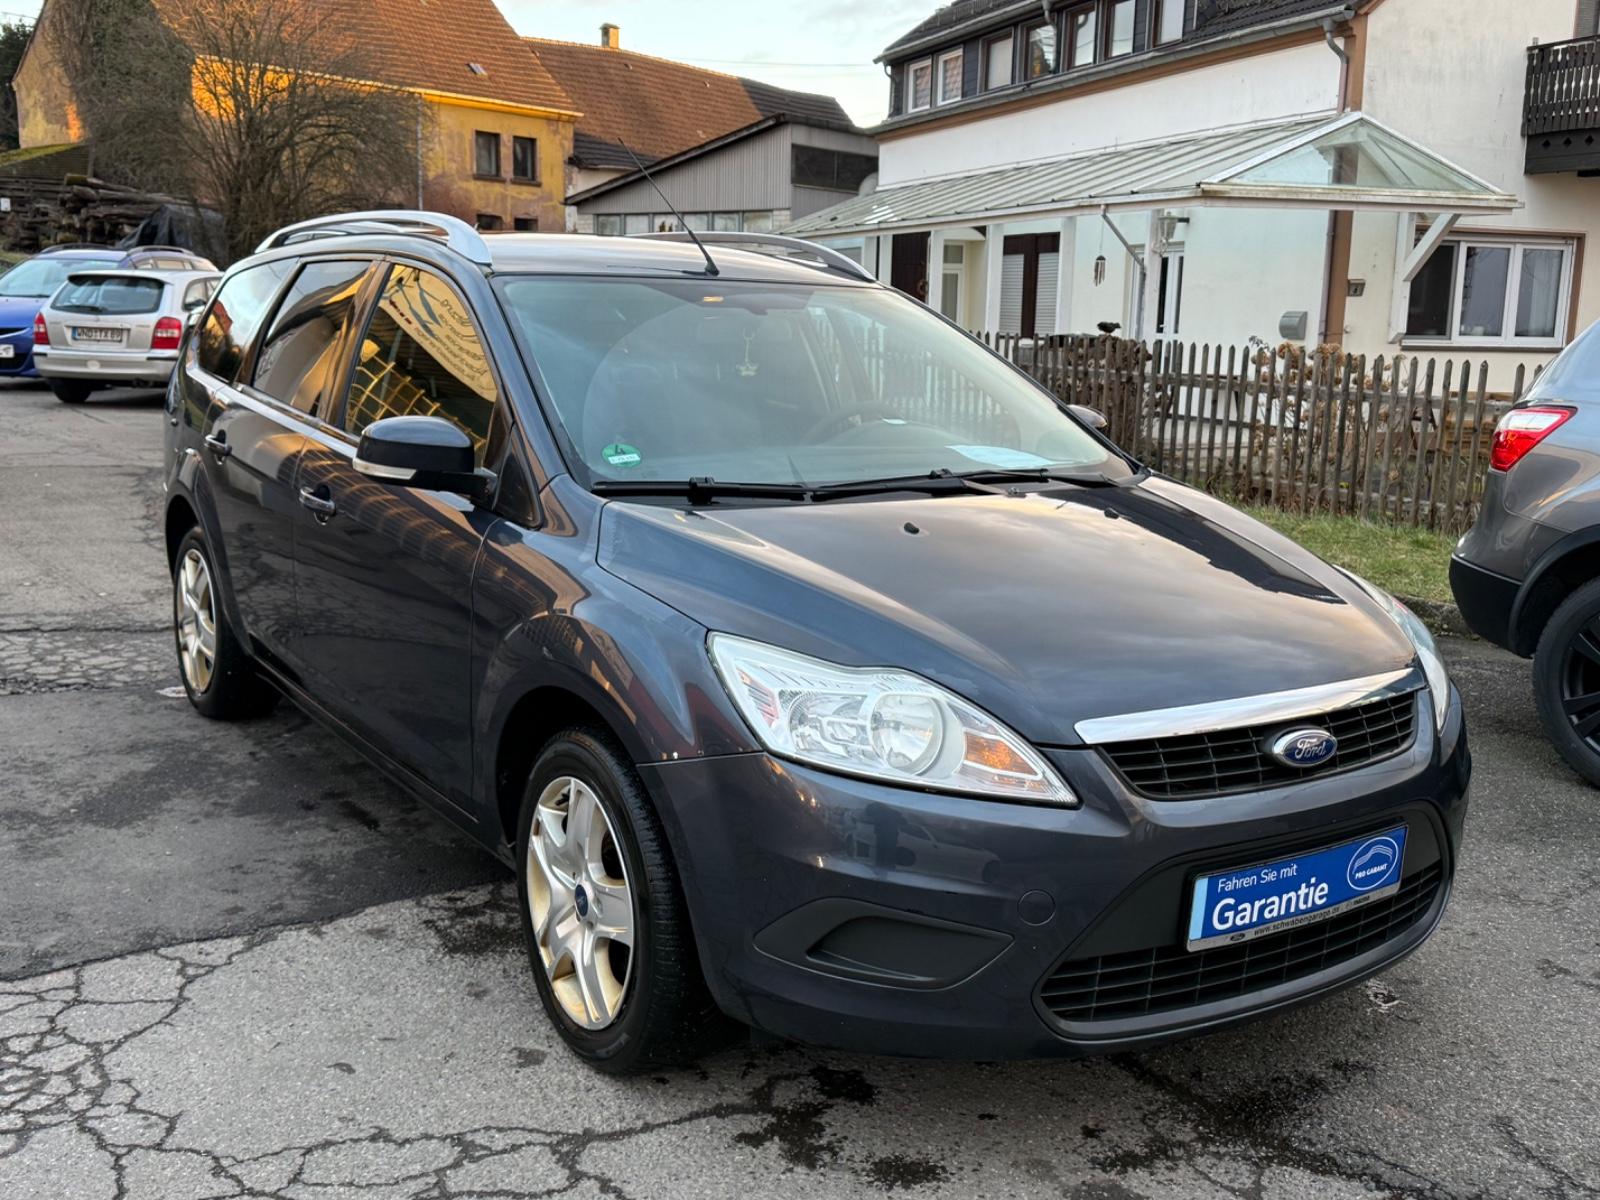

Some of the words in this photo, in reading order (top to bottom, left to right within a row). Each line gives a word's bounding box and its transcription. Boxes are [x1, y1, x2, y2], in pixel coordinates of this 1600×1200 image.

[1294, 737, 1327, 759] Ford
[1217, 875, 1257, 893] Fahren
[1260, 869, 1277, 884] Sie
[1279, 864, 1298, 879] mit
[1355, 870, 1366, 880] PRO
[1366, 863, 1388, 876] GARANT
[1212, 876, 1329, 931] Garantie
